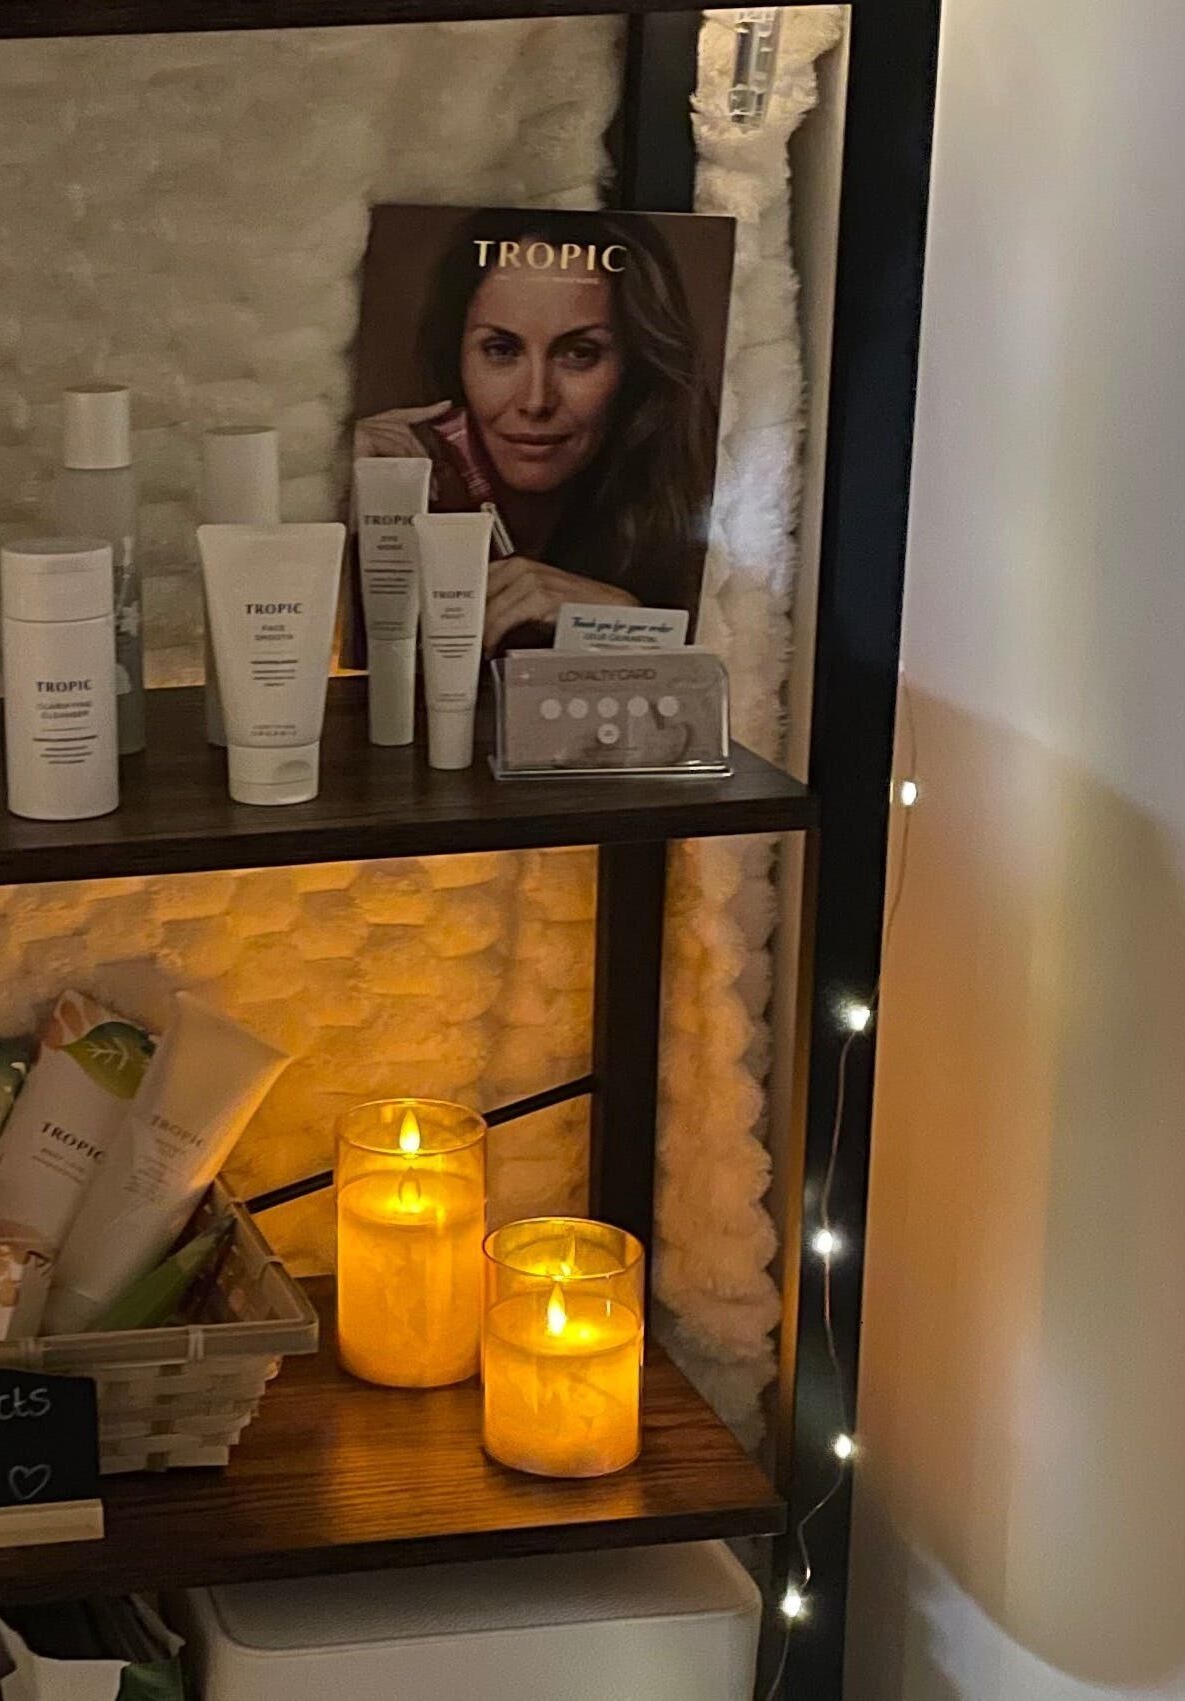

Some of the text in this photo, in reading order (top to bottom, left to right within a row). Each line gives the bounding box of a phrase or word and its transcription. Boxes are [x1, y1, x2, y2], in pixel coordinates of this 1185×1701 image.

[473, 239, 628, 273] TROPIC
[364, 515, 416, 527] TROPIC
[433, 590, 476, 599] TROPIC
[245, 603, 303, 615] TROPIC
[36, 679, 92, 692] TROPIC
[150, 1115, 205, 1147] TROPIC
[41, 1121, 106, 1161] TROPIC
